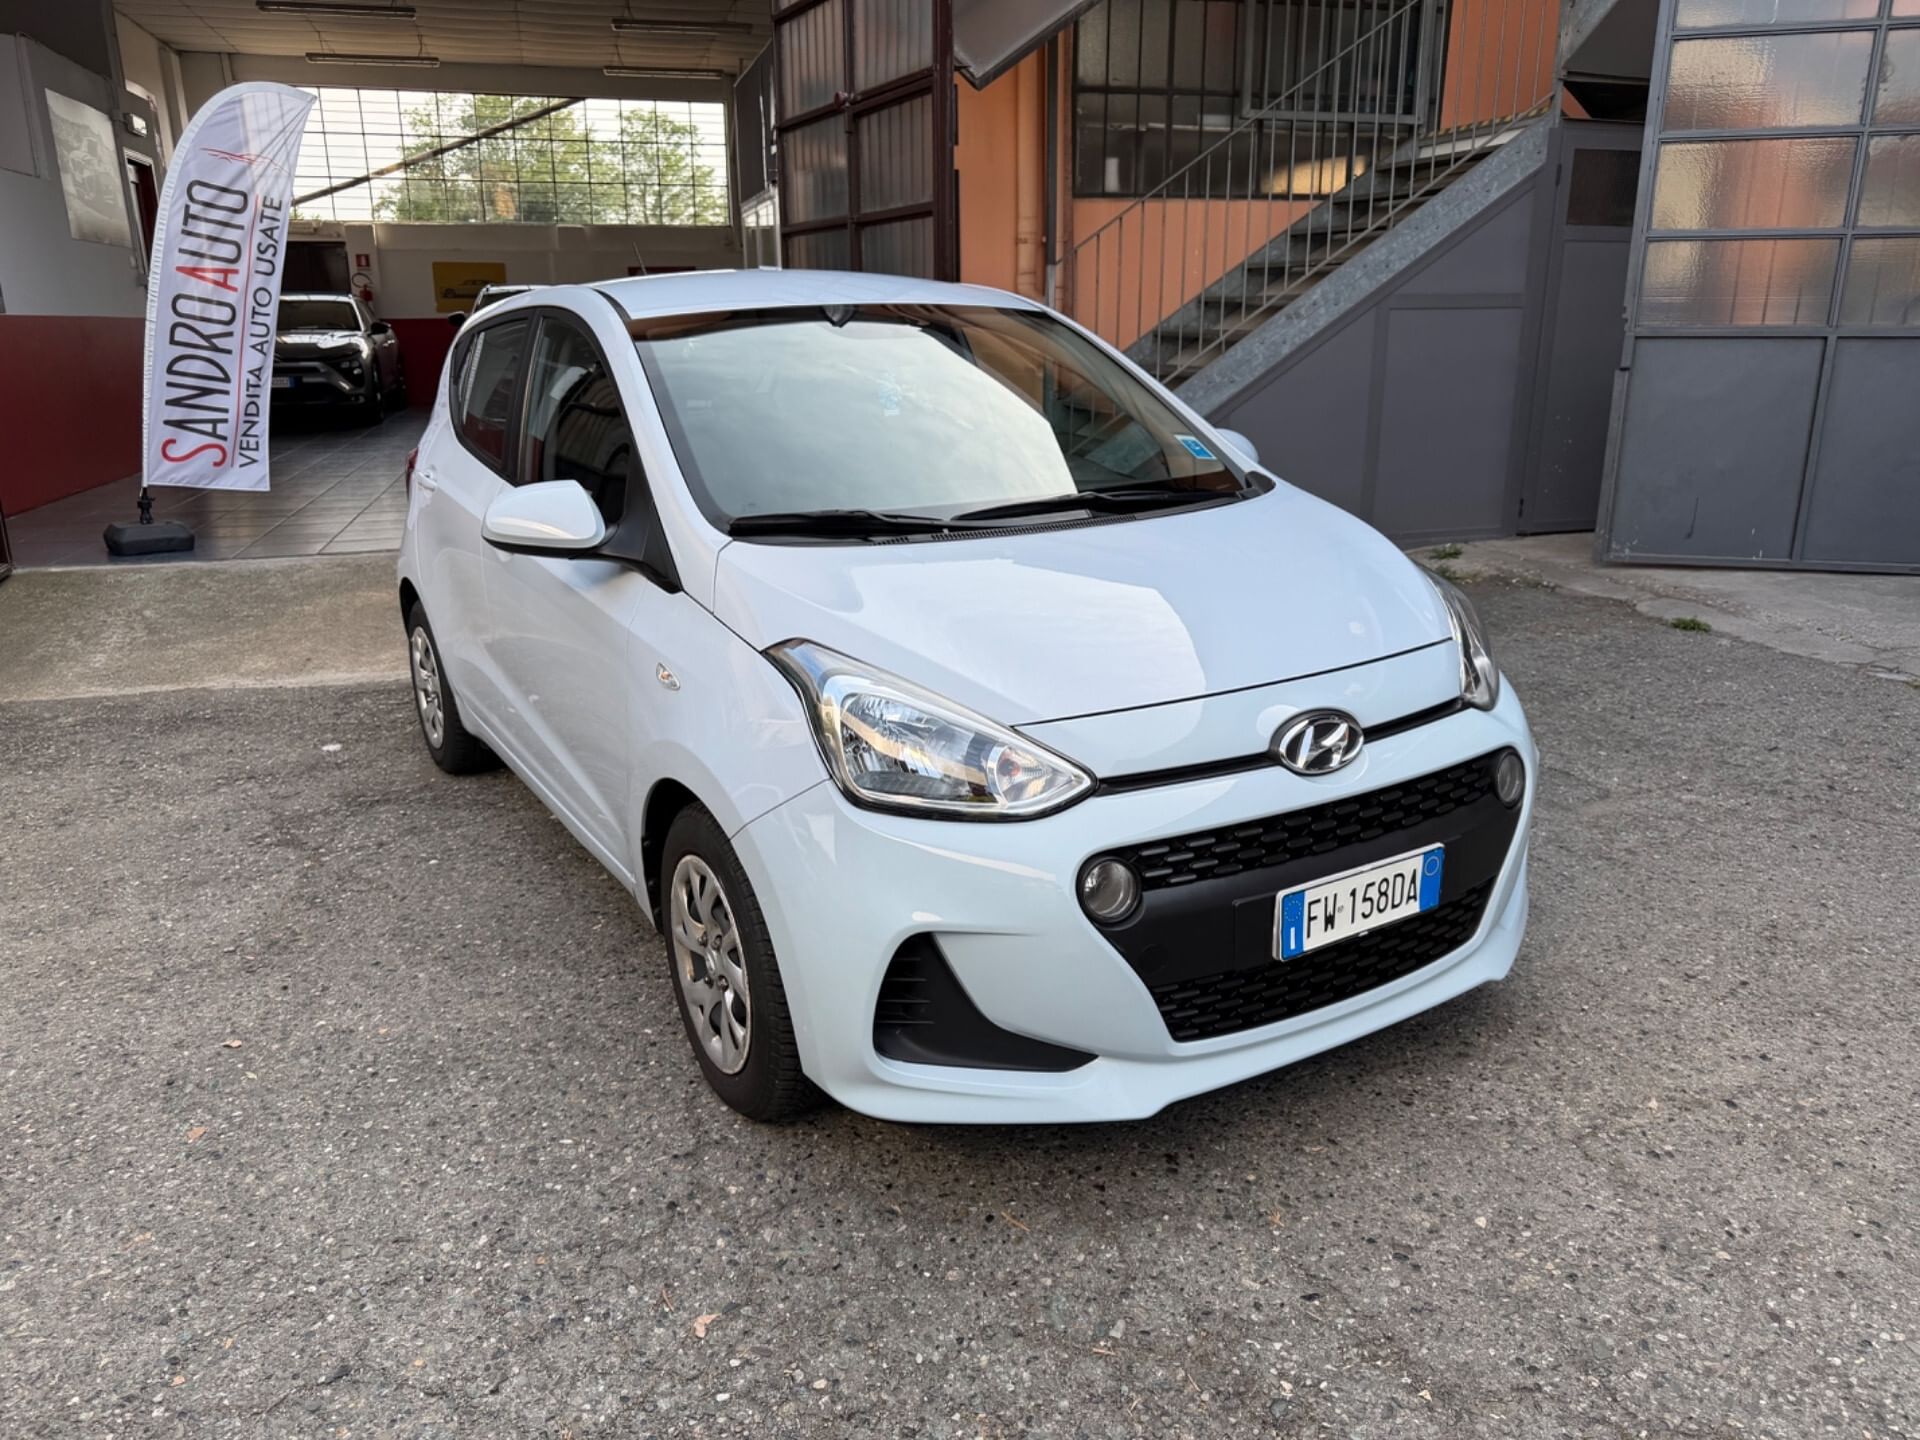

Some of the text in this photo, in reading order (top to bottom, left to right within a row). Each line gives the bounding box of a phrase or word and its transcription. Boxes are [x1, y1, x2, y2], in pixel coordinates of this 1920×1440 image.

[161, 179, 248, 468] SANDRO AUTO
[239, 195, 283, 469] VENDITA AUTO USATE
[1307, 868, 1418, 939] FW 158DA
